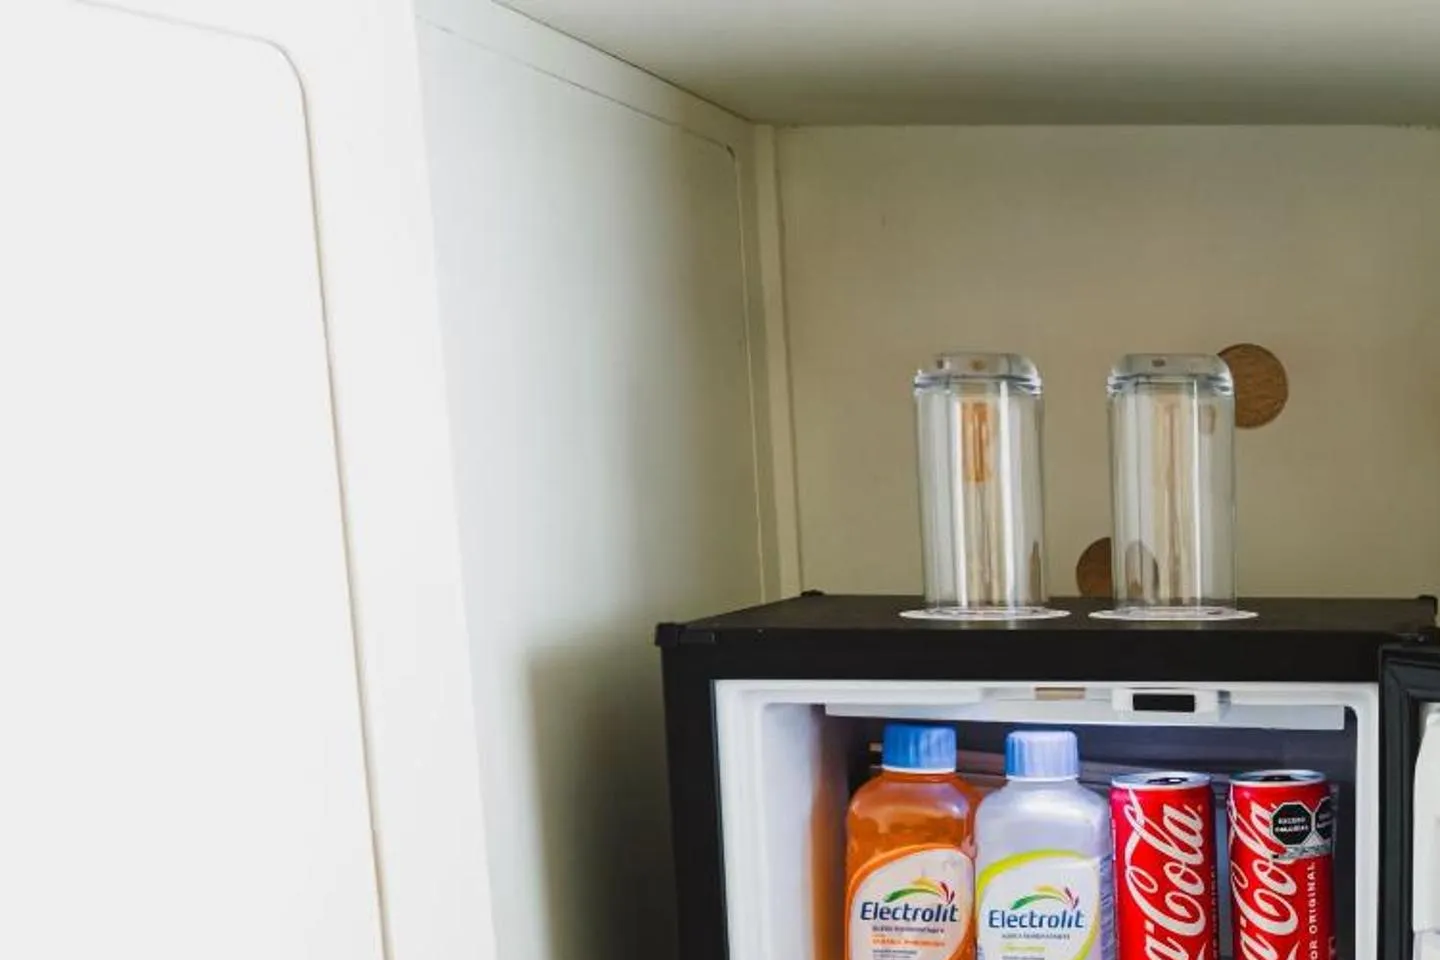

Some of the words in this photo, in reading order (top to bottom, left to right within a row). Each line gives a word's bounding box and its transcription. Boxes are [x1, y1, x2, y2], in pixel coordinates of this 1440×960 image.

[1307, 862, 1318, 934] ORIGINAL
[860, 901, 959, 922] Electrolit
[988, 909, 1085, 929] Electrolit
